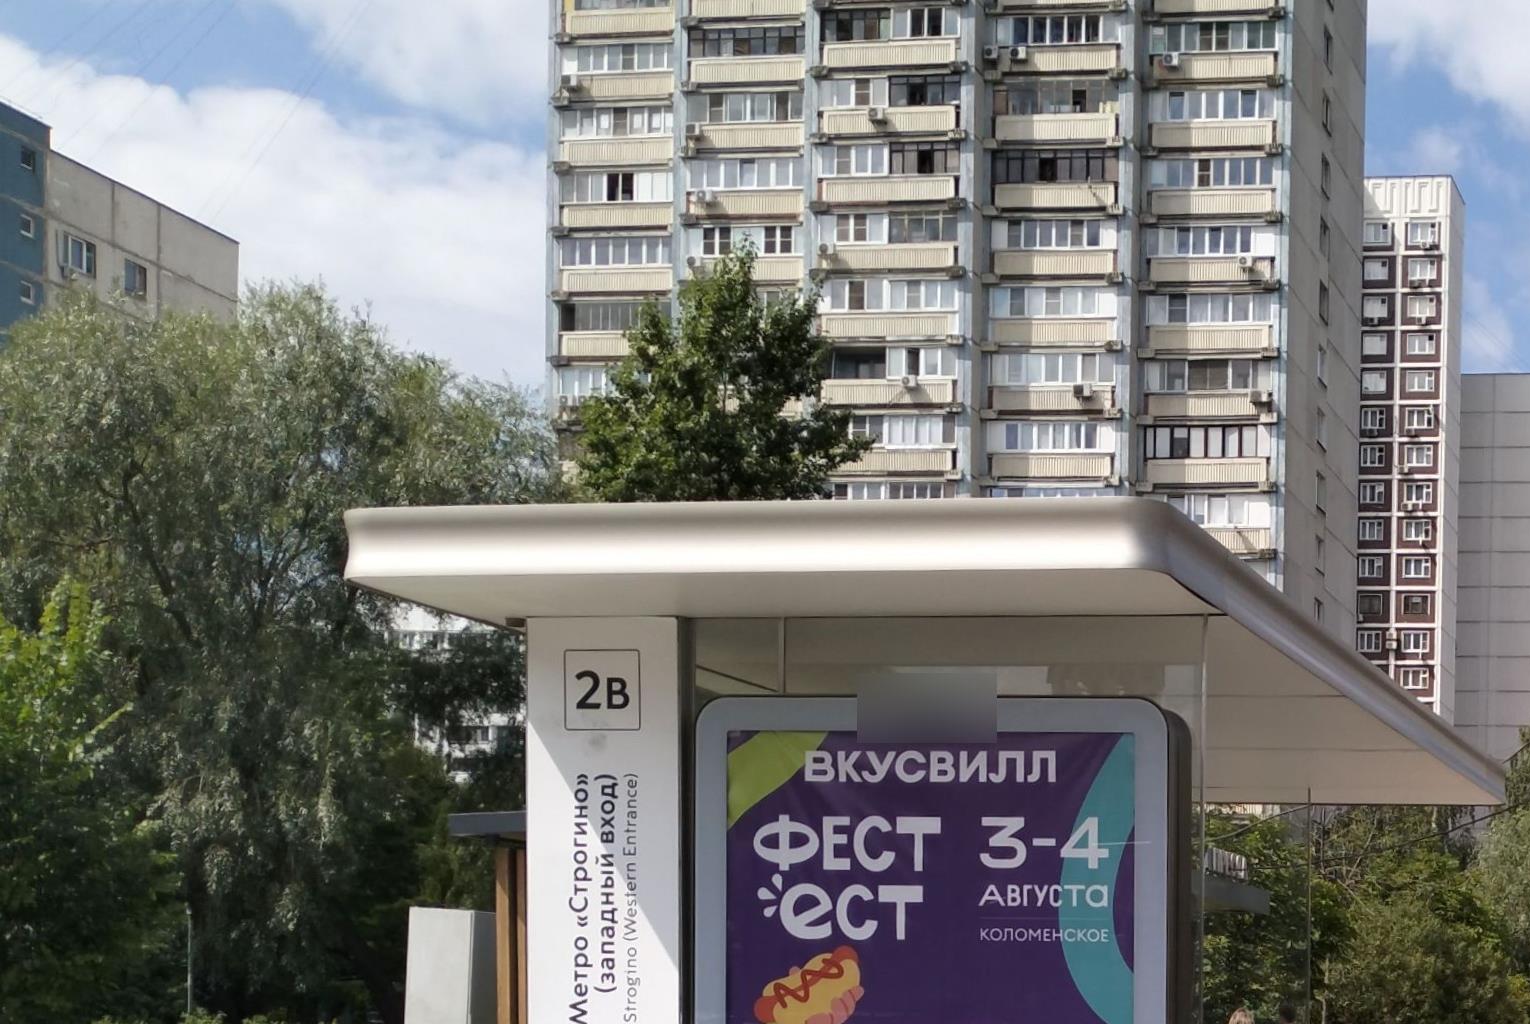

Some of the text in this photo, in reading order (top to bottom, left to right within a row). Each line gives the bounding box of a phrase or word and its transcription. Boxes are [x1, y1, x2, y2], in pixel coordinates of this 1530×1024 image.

[803, 750, 1057, 783] ВКУСВИЛЛ
[568, 772, 593, 928] «Строгино»
[623, 772, 639, 857] Entrance)
[753, 814, 941, 872] ФЕСТ
[980, 816, 1109, 870] 3-4
[594, 773, 617, 994] (западный вход)
[623, 870, 639, 943] (Western
[979, 928, 1109, 943] КОЛОМЕНСКОЕ
[623, 947, 641, 1023] Strogino
